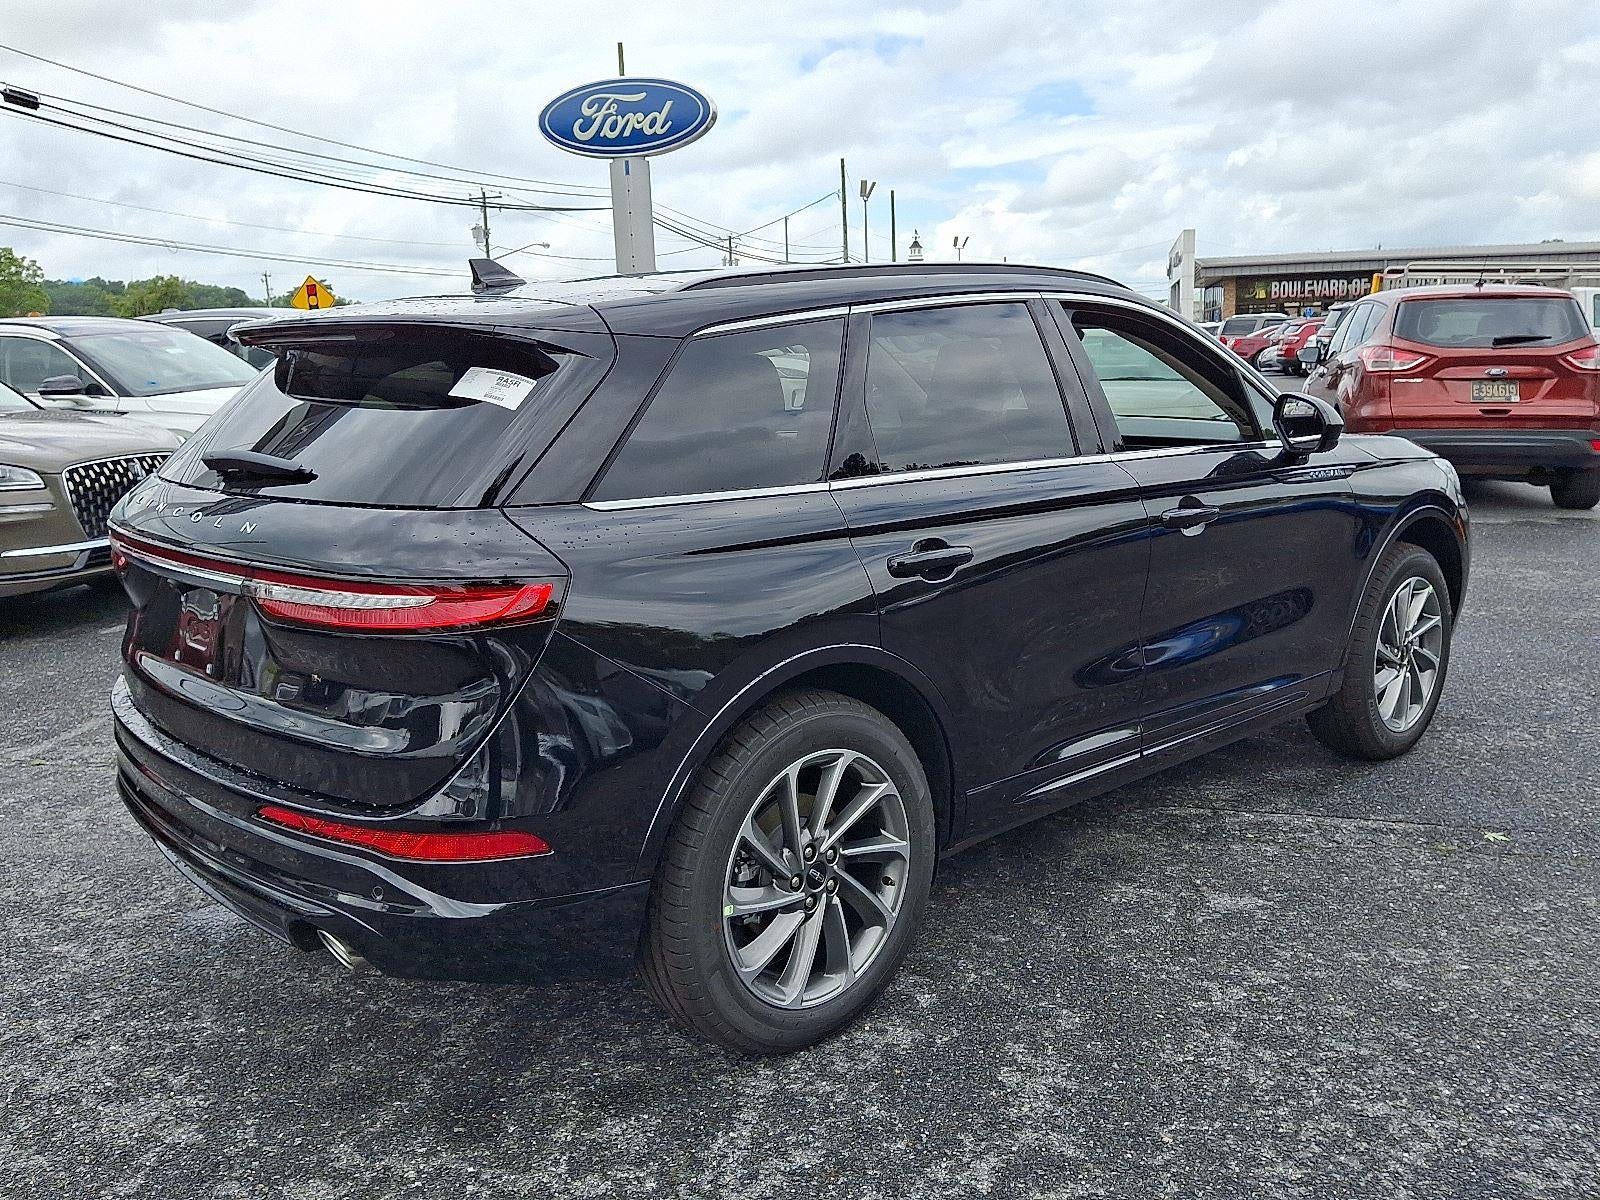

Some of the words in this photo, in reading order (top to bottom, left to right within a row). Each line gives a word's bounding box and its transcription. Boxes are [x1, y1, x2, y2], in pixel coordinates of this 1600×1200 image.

[572, 91, 674, 141] Ford
[1270, 279, 1348, 299] BOULEVARD
[1350, 277, 1371, 297] OF
[136, 496, 258, 535] LINCOLN
